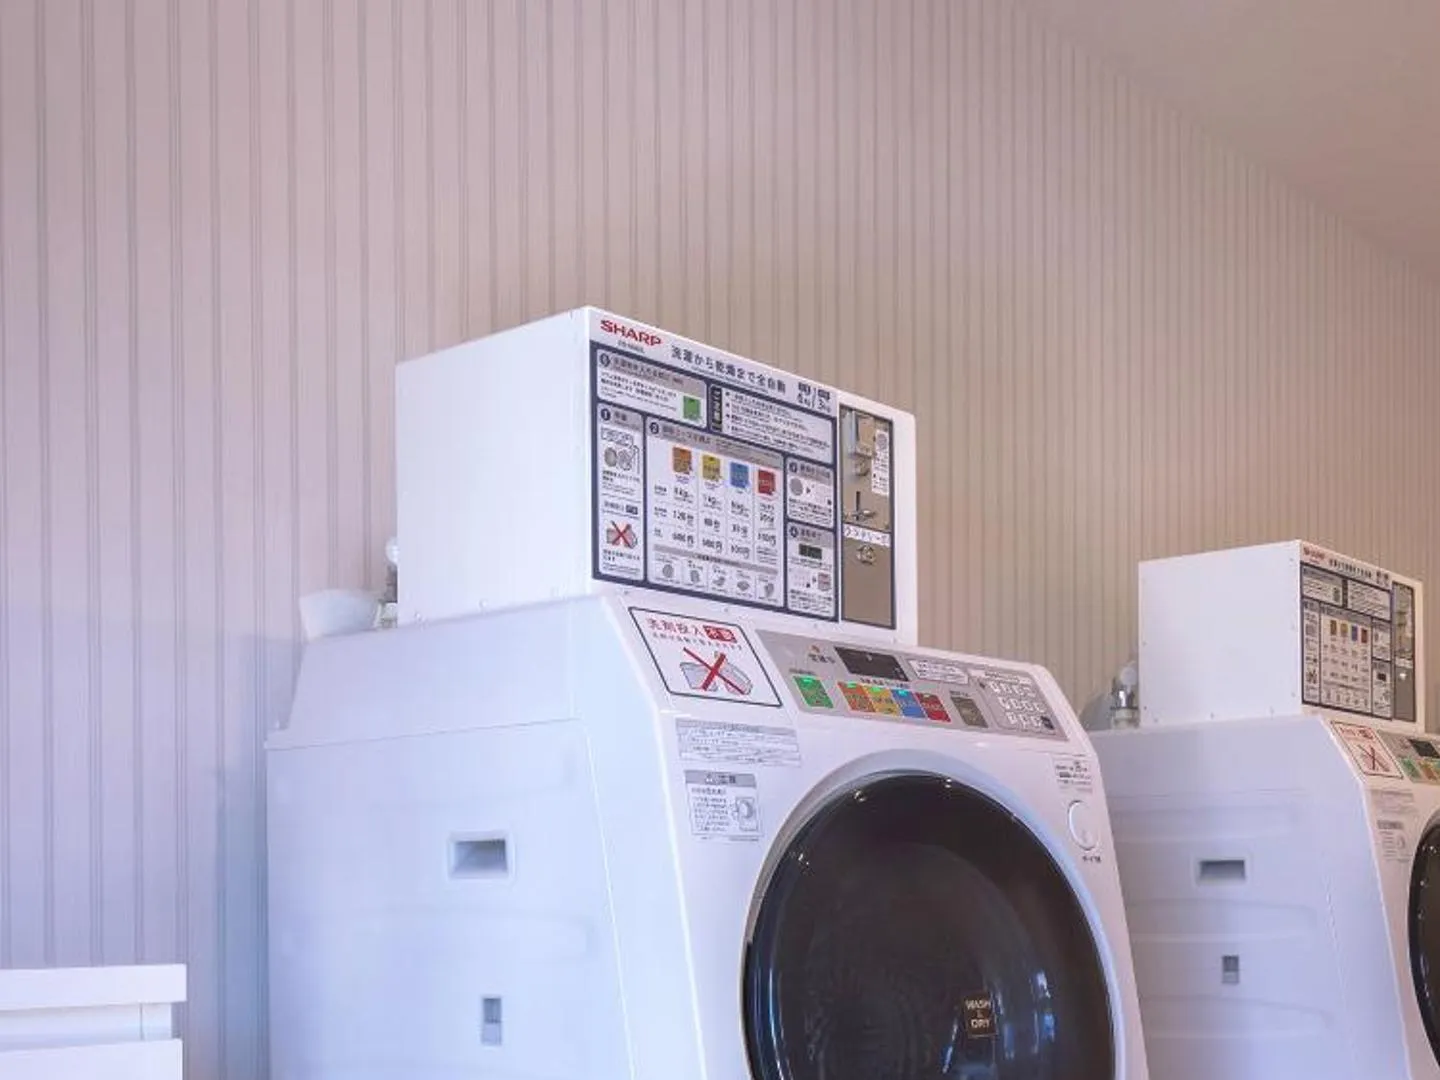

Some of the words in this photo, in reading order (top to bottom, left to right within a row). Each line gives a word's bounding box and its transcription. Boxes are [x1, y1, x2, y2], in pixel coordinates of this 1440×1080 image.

[600, 319, 662, 347] SHARP
[965, 999, 991, 1009] WASH
[971, 1019, 989, 1028] DRY
